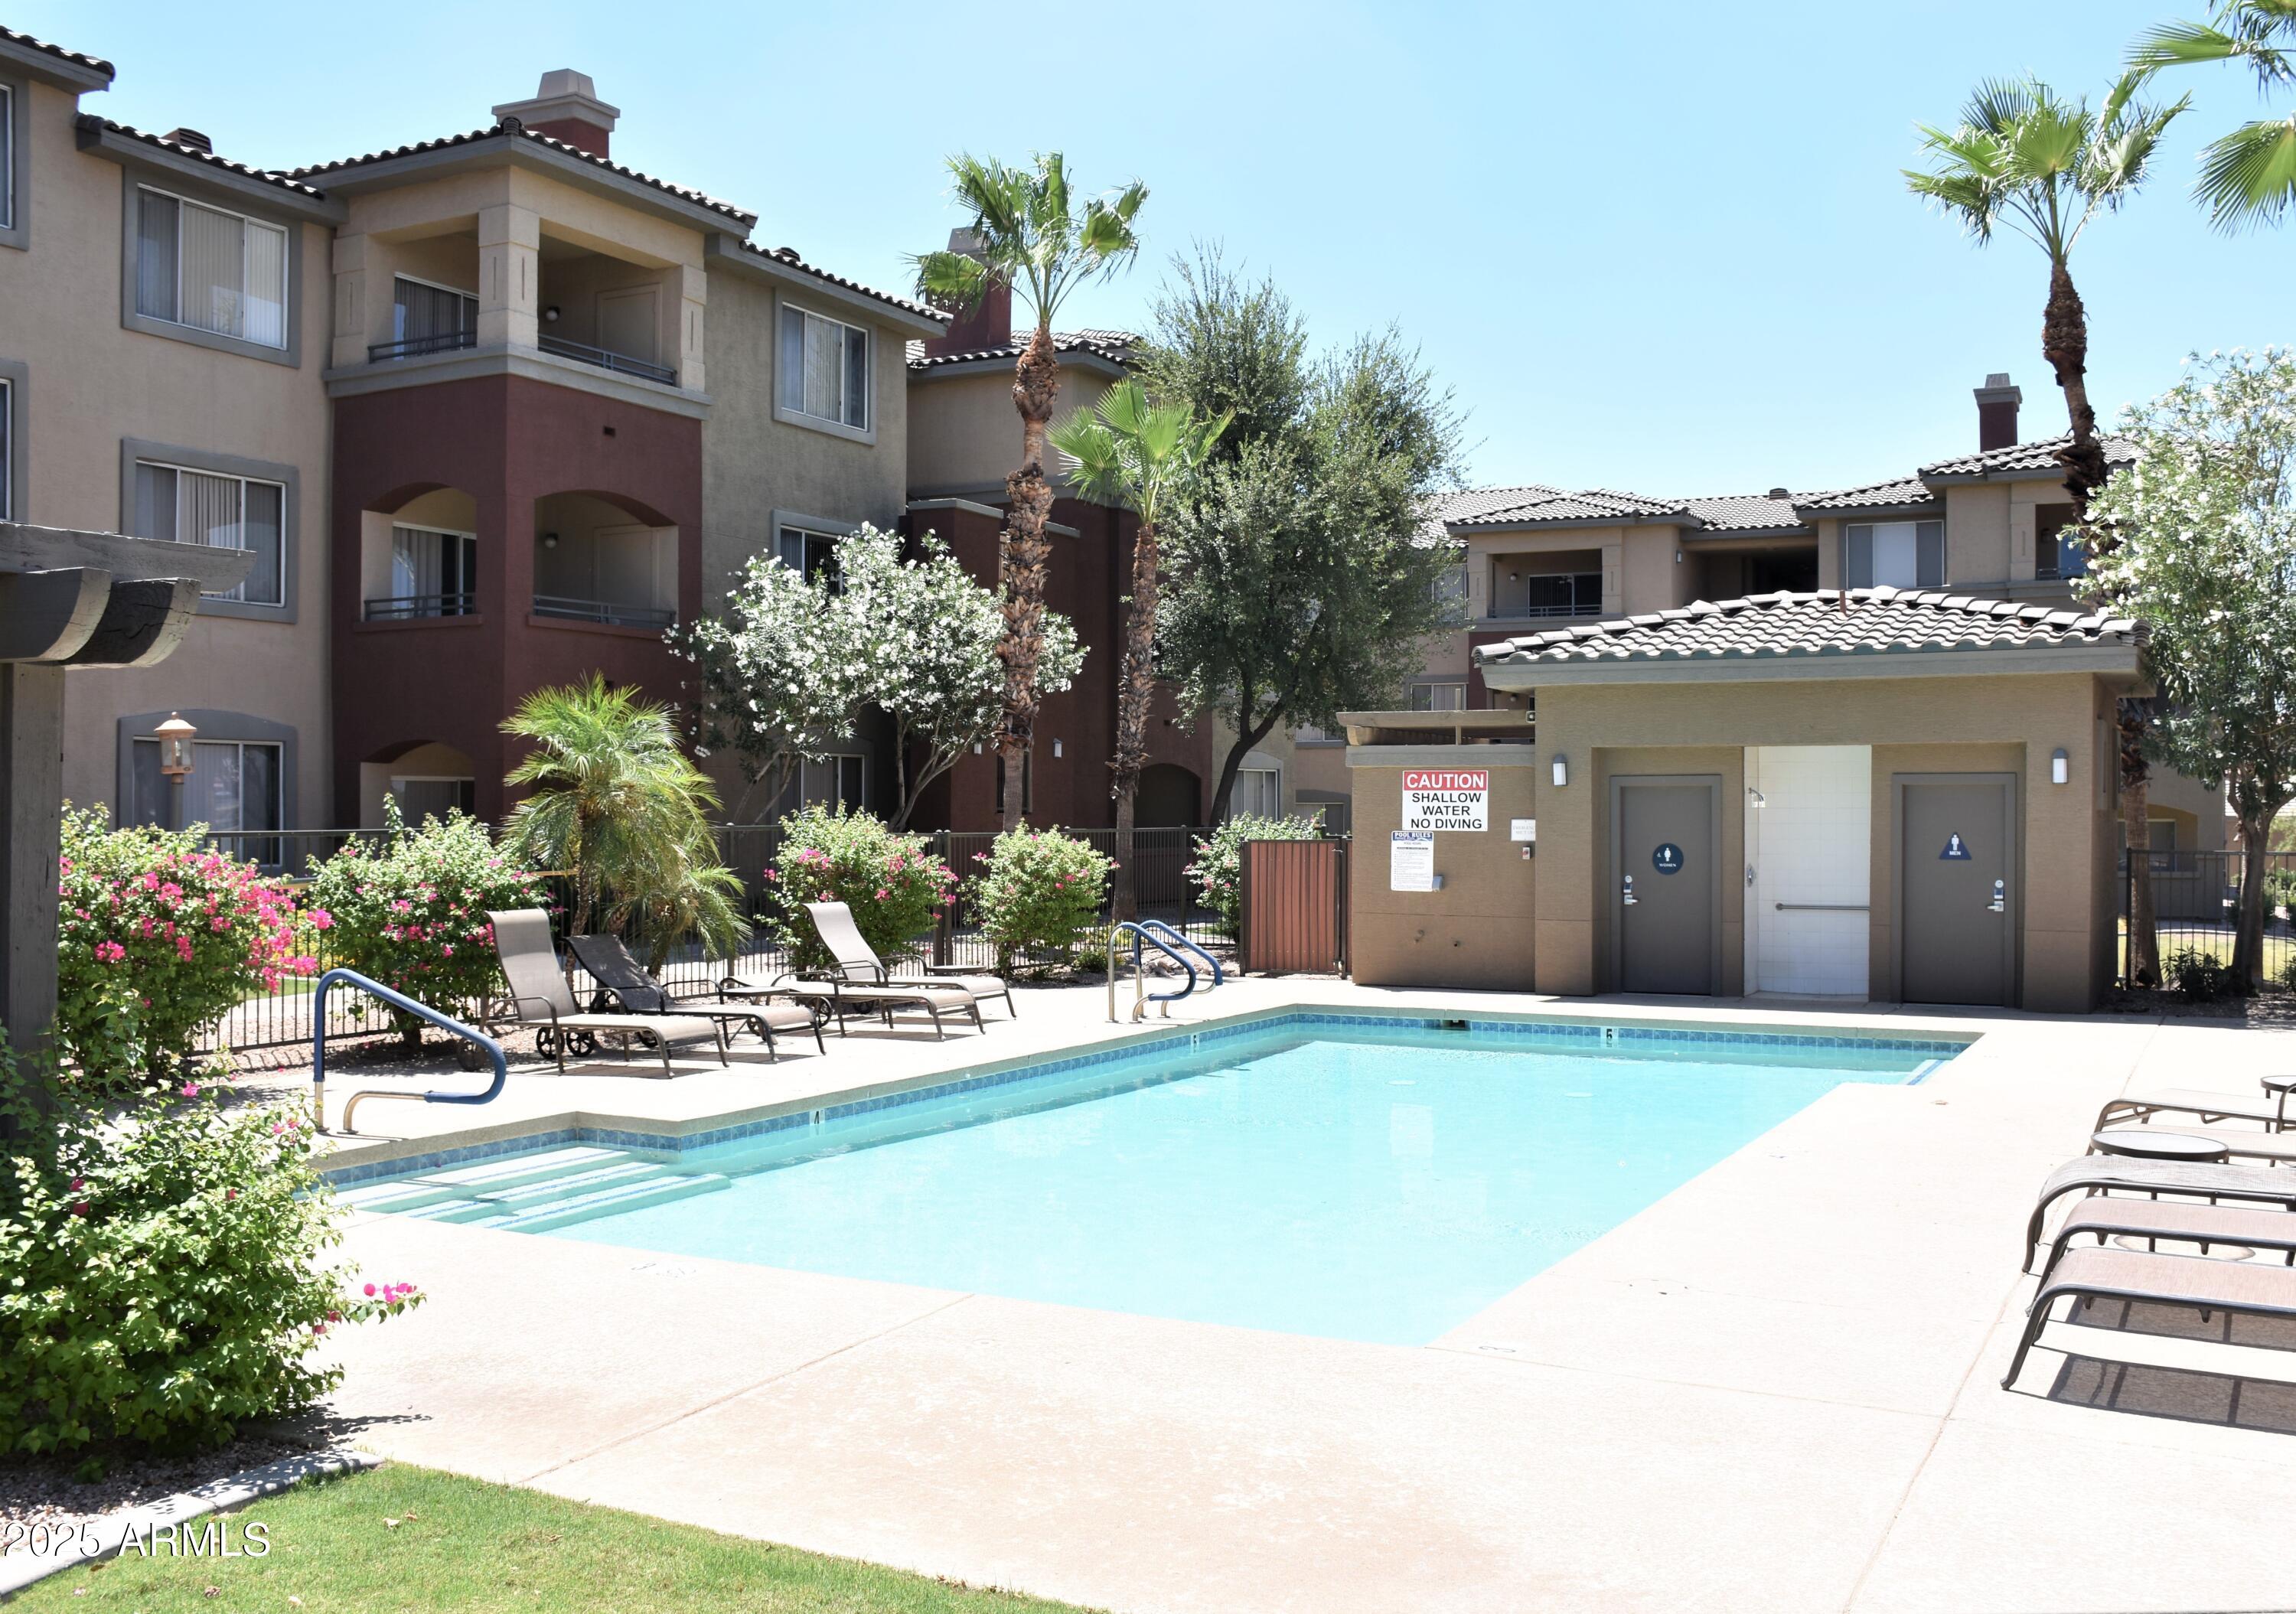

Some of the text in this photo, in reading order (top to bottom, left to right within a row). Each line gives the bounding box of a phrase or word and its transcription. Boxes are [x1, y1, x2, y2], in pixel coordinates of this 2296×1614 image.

[1407, 774, 1483, 787] CAUTION
[1411, 792, 1481, 802] SHALLOW
[1422, 806, 1470, 816] WATER
[1411, 819, 1482, 829] NO DIVING
